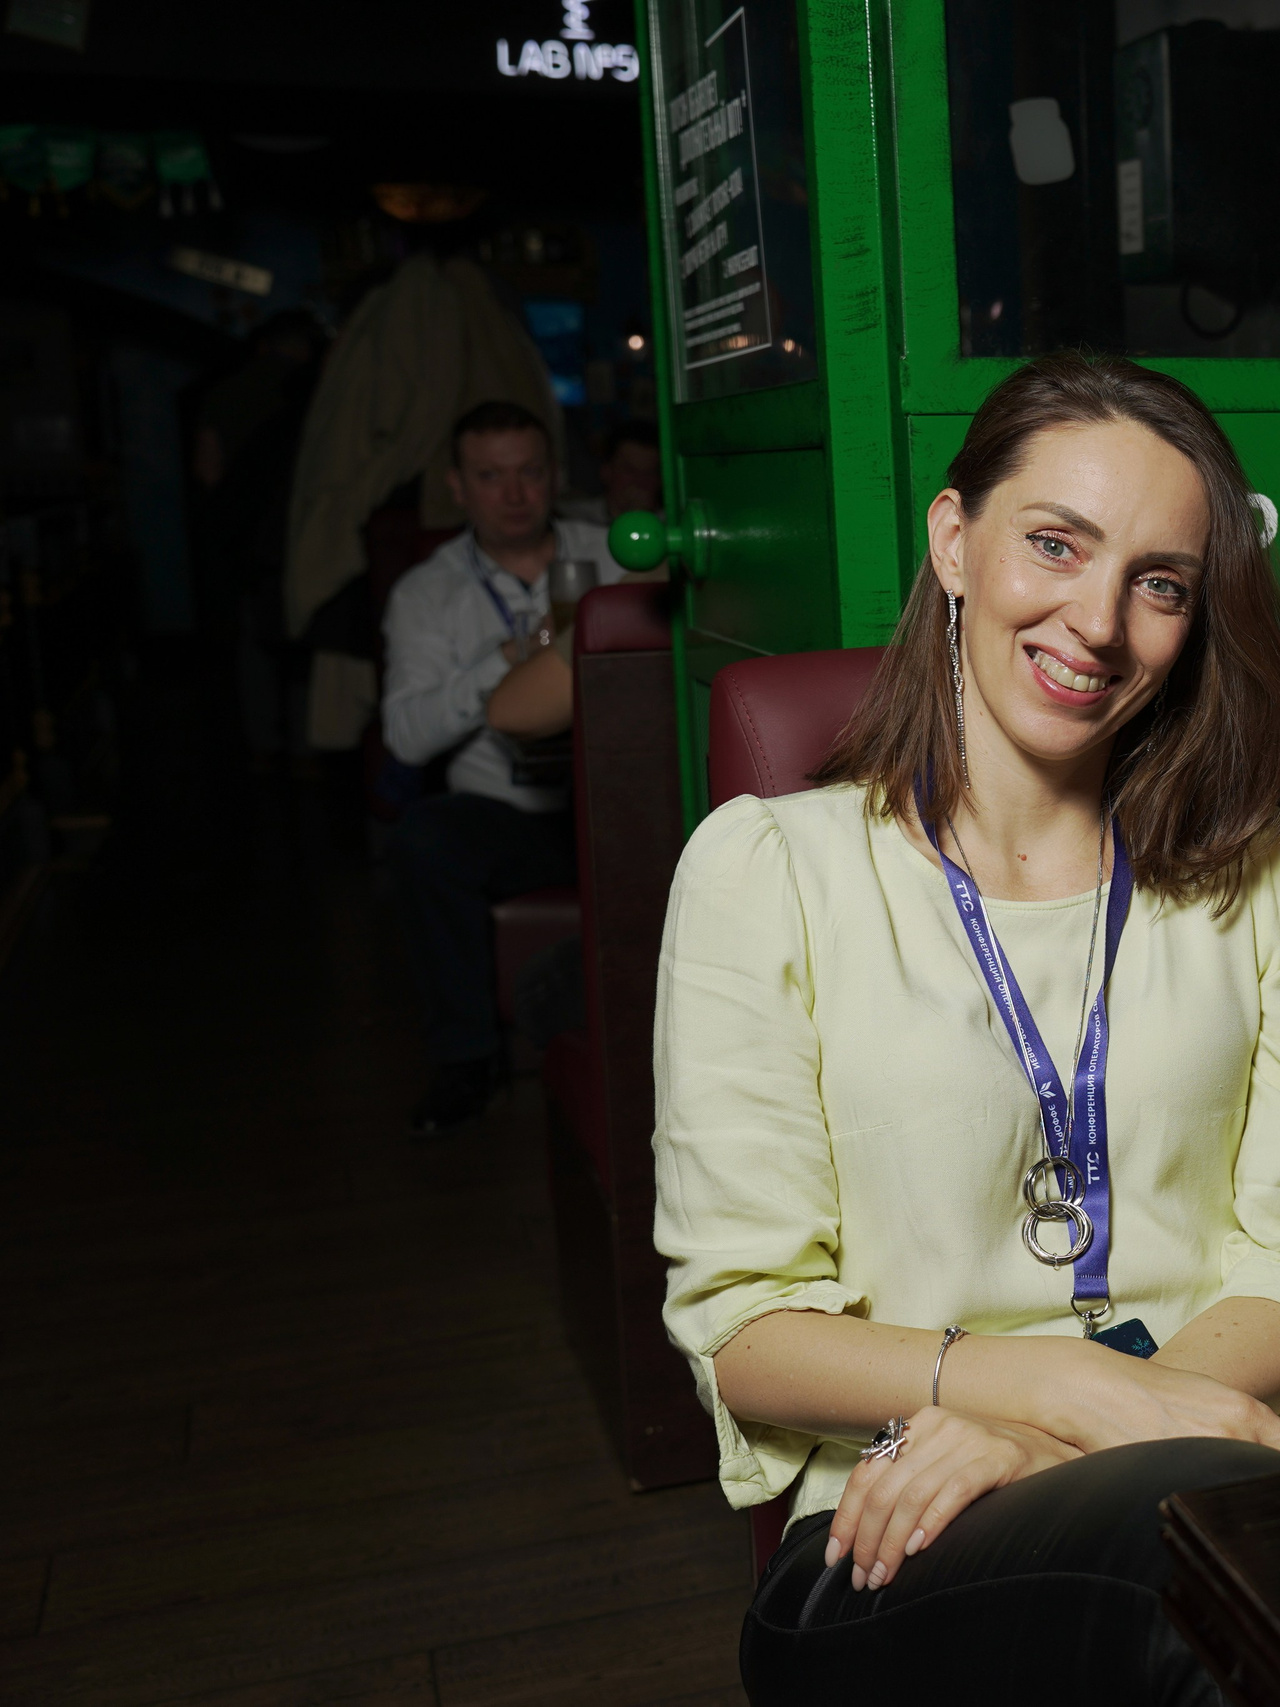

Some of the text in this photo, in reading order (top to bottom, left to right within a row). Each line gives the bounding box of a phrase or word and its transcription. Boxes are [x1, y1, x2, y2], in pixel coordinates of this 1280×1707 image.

[496, 38, 572, 79] LAB
[970, 917, 1003, 983] КОНФЕРЕНЦИЯ
[1088, 1013, 1102, 1072] ОПЕРАТОРОВ
[1087, 1074, 1098, 1145] КОНФЕРЕНЦИЯ
